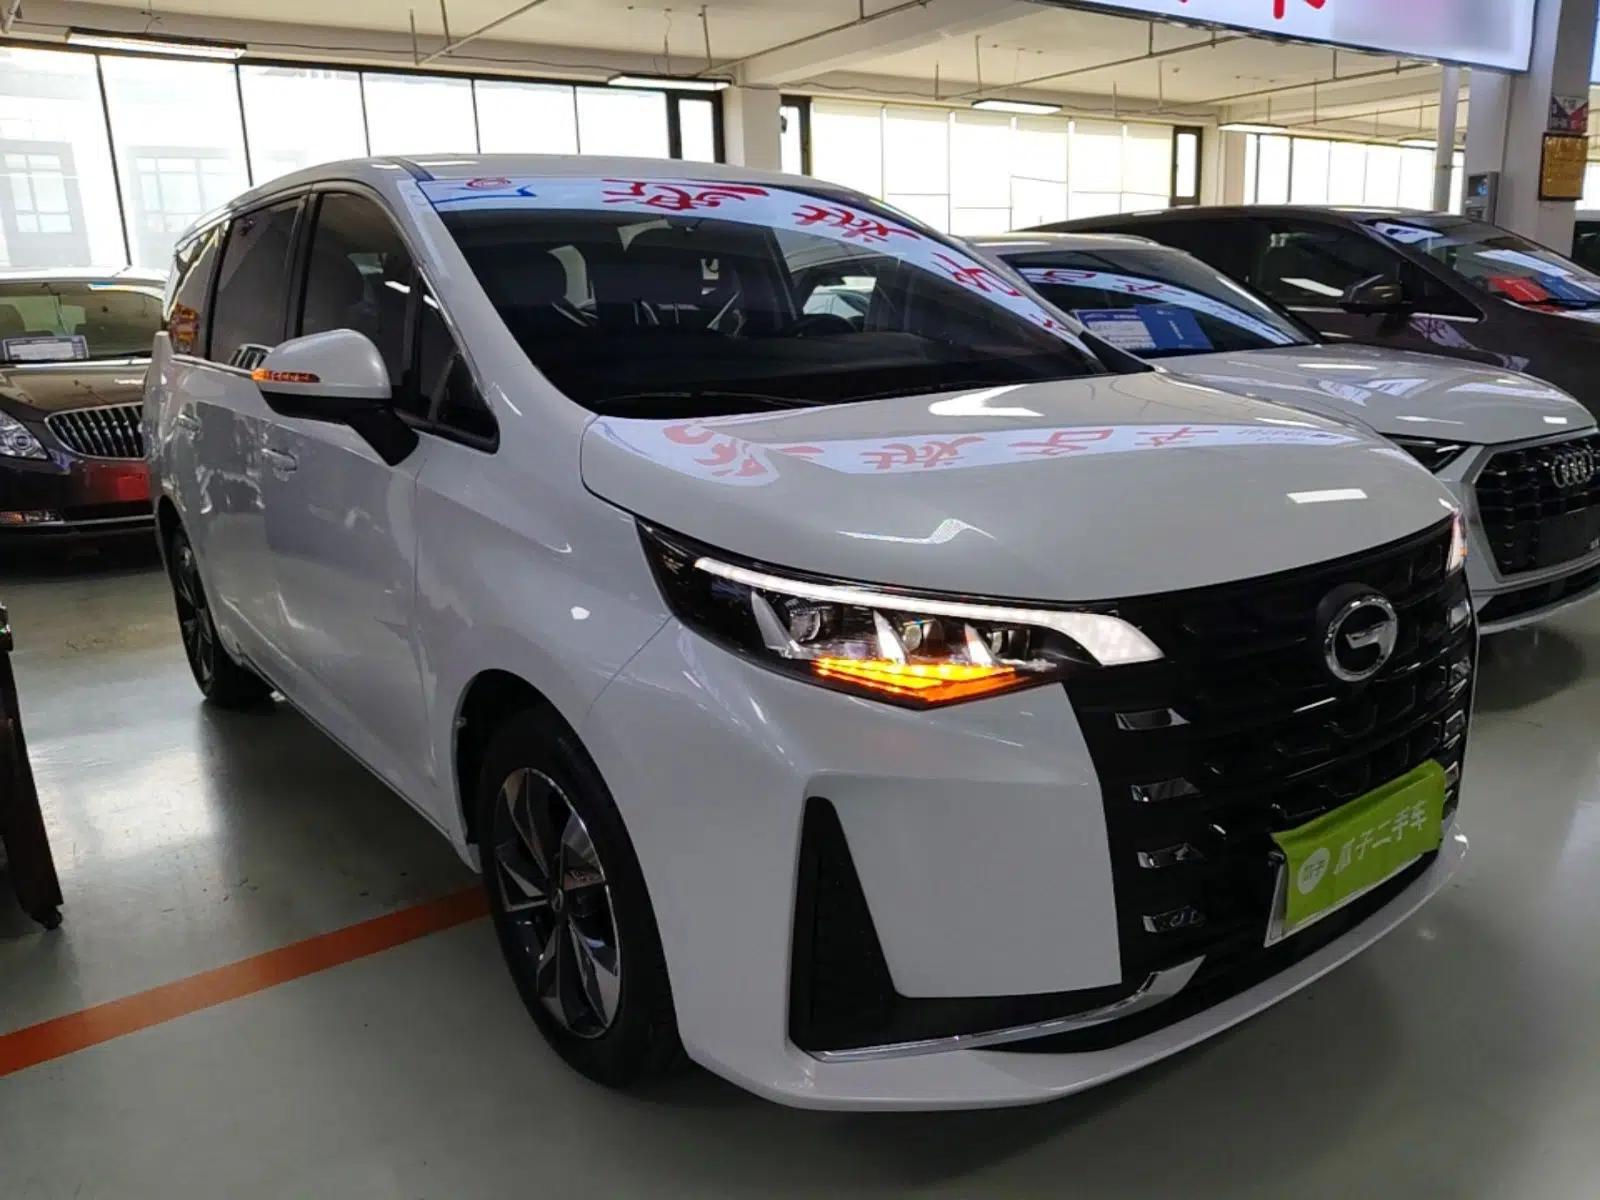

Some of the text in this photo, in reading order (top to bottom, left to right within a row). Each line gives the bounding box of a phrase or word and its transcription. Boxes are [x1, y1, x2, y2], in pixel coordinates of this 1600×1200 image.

[1333, 800, 1427, 875] 瓜子二手车
